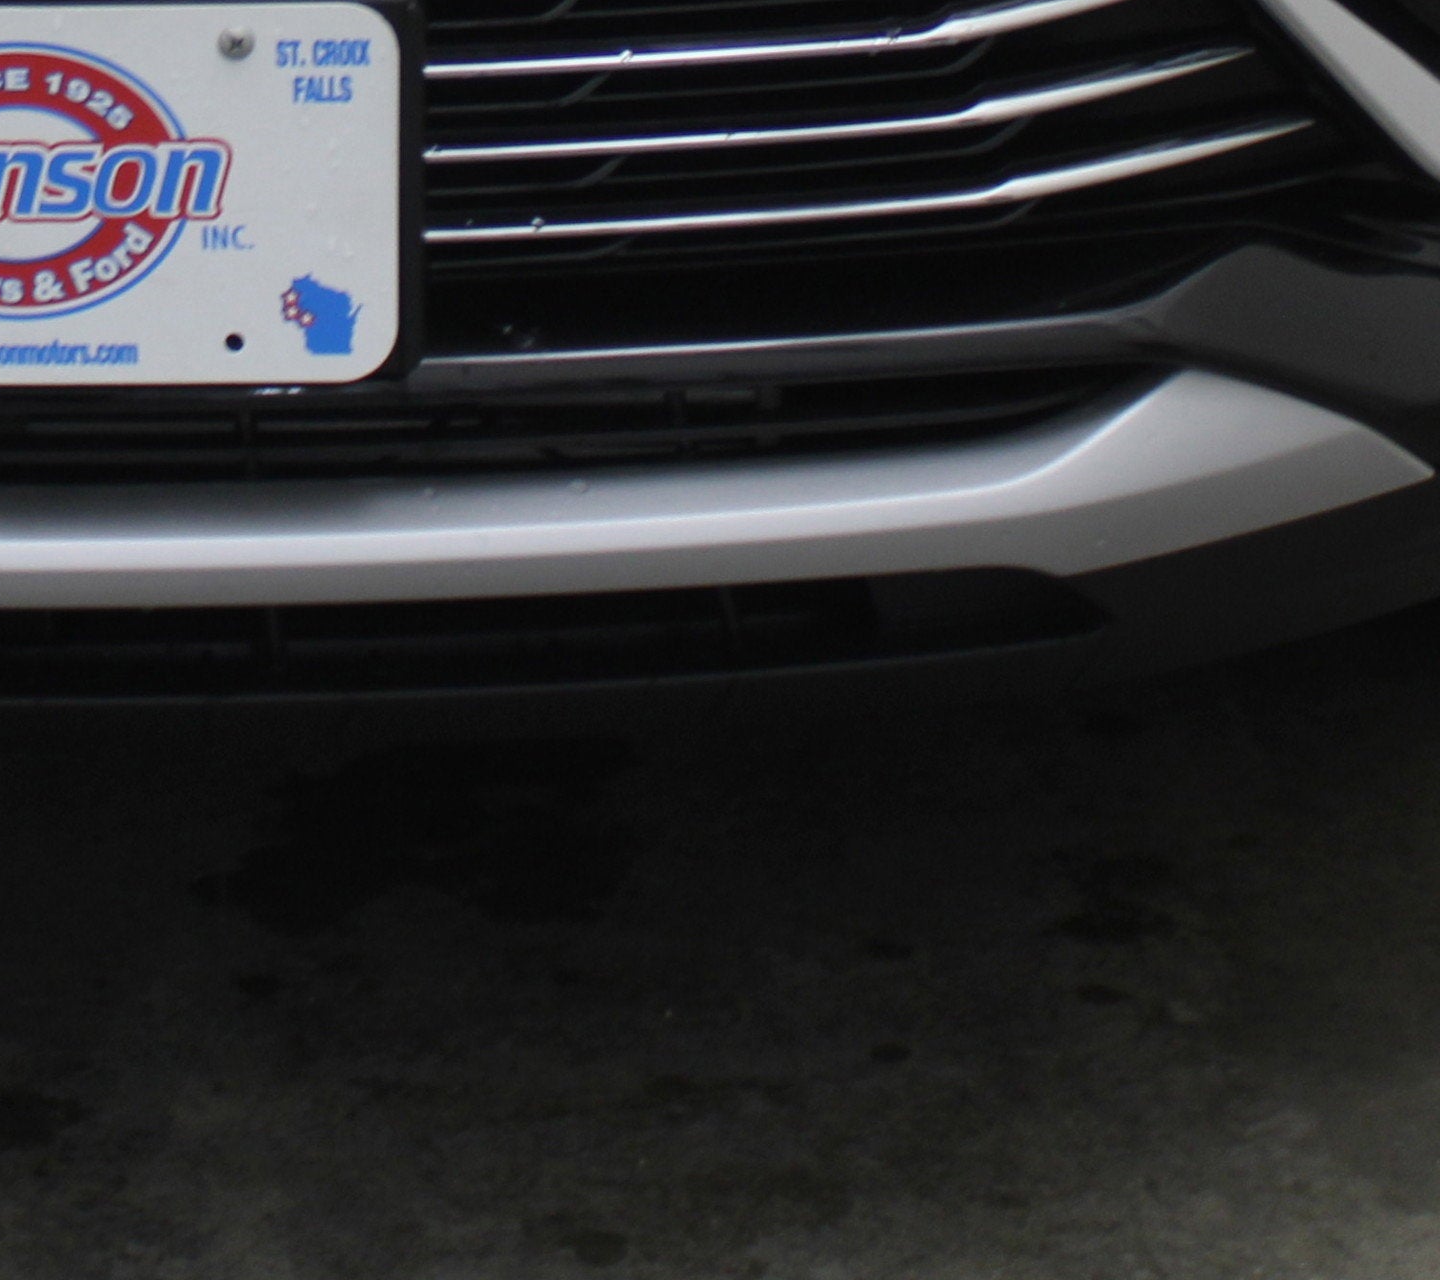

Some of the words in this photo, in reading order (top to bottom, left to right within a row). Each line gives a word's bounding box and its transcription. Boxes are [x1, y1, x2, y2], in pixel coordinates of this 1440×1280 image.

[276, 41, 307, 66] ST.
[313, 40, 370, 66] CROIX
[45, 72, 135, 131] 1925
[293, 76, 352, 102] FALLS
[202, 225, 255, 250] INC.
[32, 270, 65, 302] &
[69, 222, 153, 293] Ford
